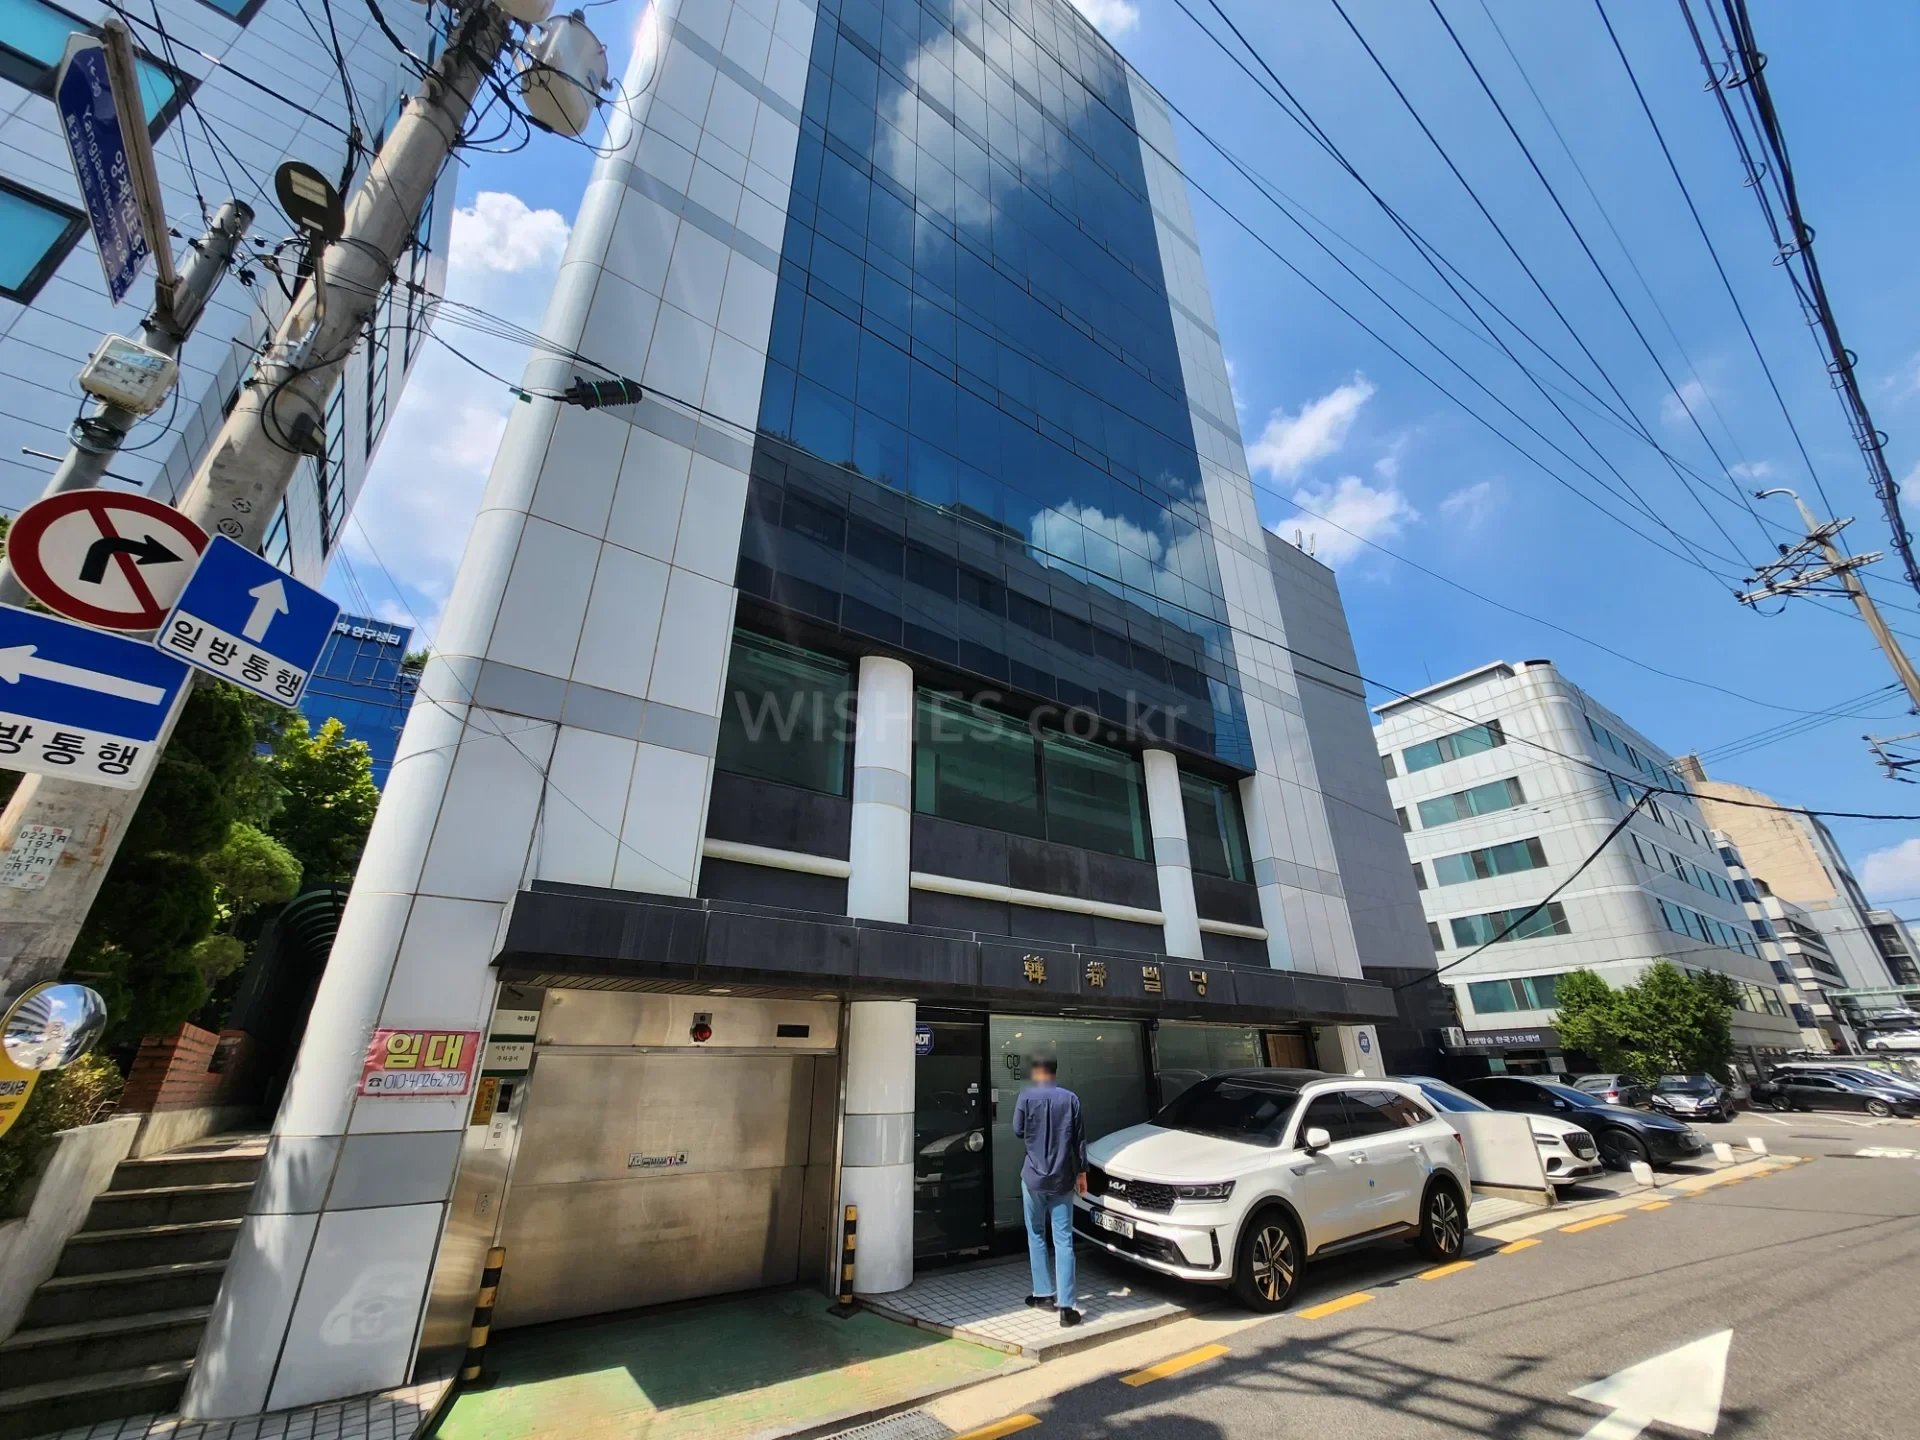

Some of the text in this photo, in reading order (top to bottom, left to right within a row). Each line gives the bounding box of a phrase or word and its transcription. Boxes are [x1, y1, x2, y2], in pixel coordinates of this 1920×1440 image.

[352, 626, 401, 646] 연구센터
[170, 620, 302, 698] 일방통행
[27, 840, 53, 849] 192
[1495, 1034, 1541, 1044] 한국가요채널
[384, 1032, 465, 1069] 임대
[1108, 1180, 1126, 1191] KIA
